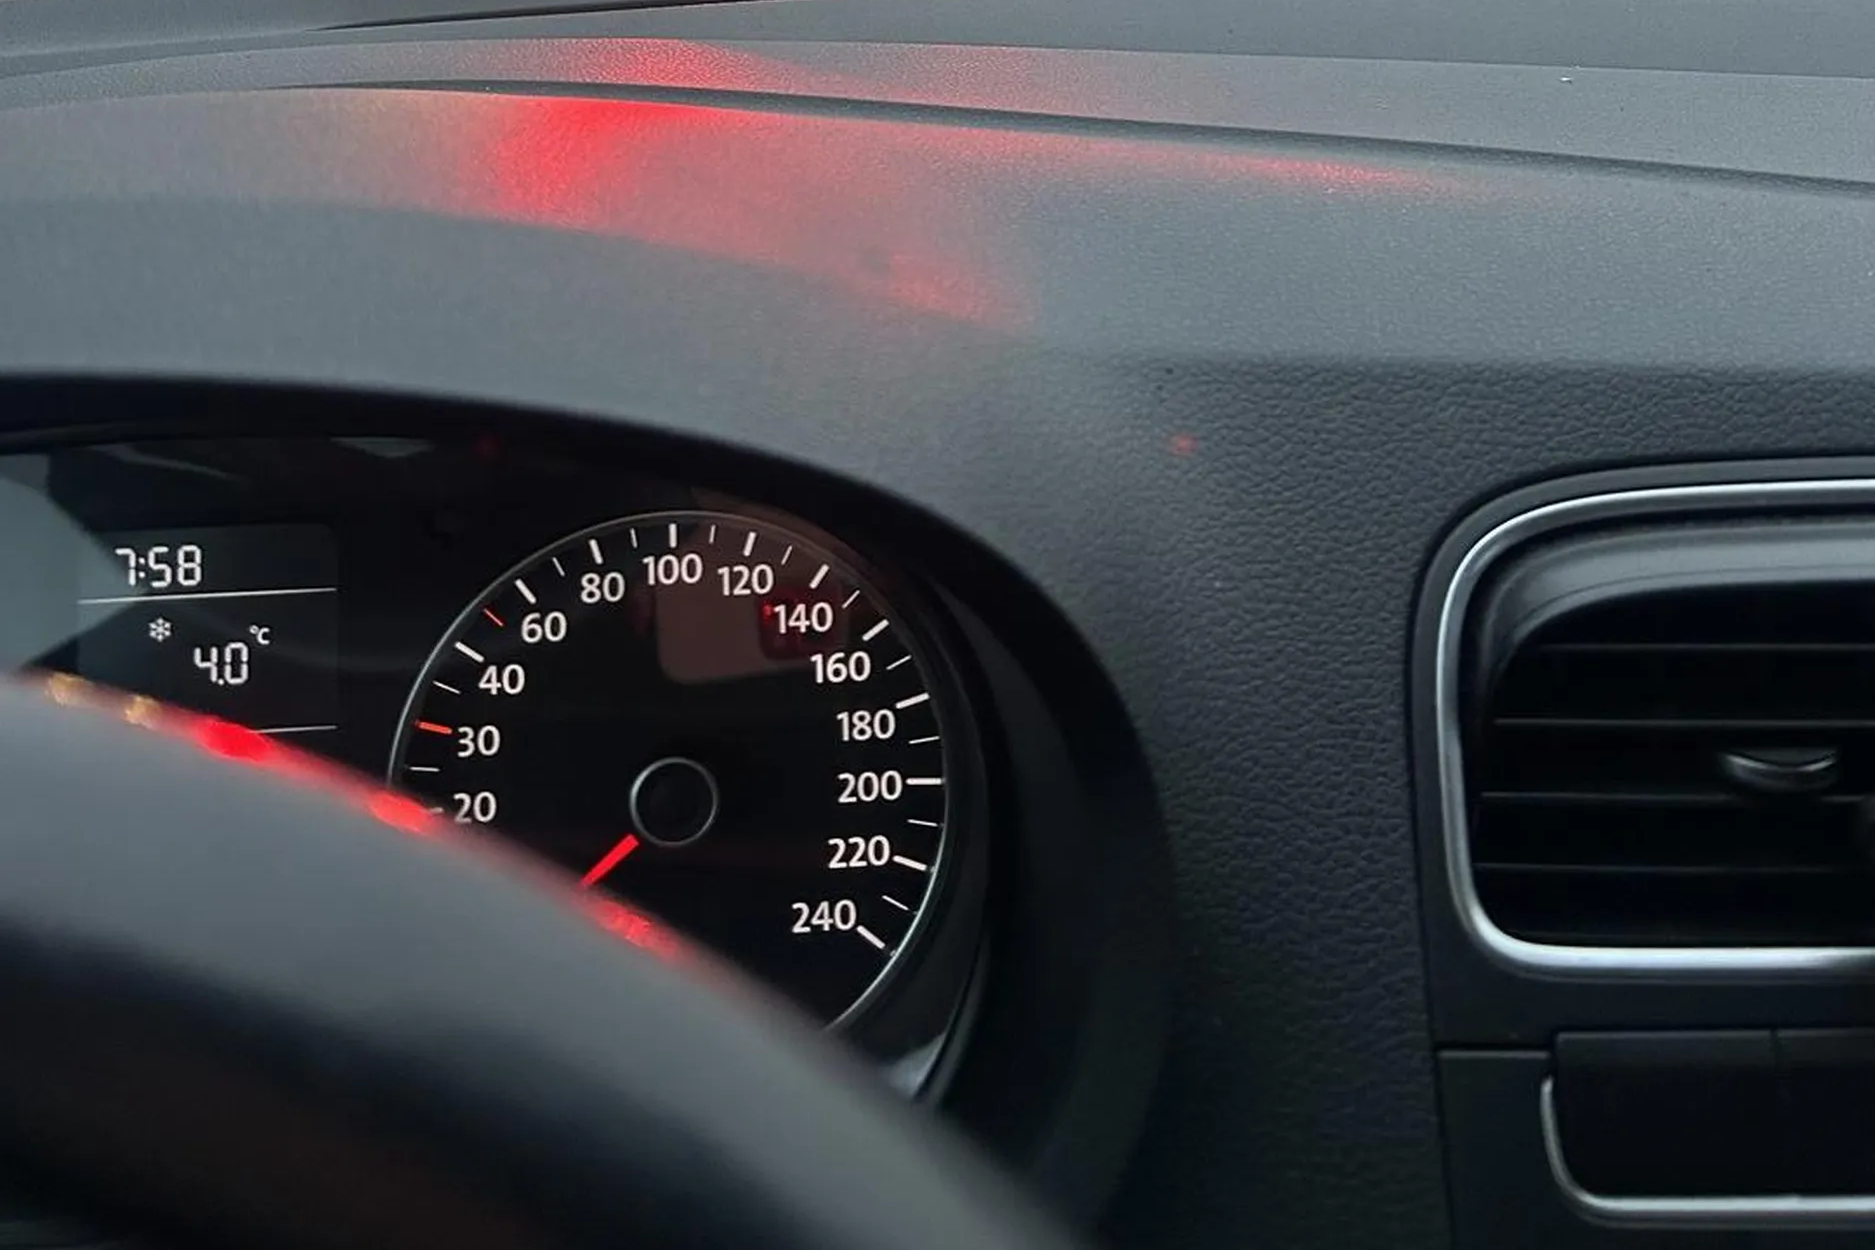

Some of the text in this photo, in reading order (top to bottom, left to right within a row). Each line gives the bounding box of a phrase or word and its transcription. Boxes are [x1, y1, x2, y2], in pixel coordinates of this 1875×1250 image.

[115, 545, 202, 588] 7:58
[642, 553, 703, 586] 100
[717, 563, 774, 596] 120
[580, 572, 625, 604] 80
[521, 611, 567, 643] 60
[773, 601, 833, 634] 140
[194, 642, 249, 685] 4.0
[478, 664, 525, 695] 40
[810, 650, 871, 684] 160
[457, 725, 501, 758] 30
[836, 708, 896, 742] 180
[838, 770, 903, 803] 200
[453, 791, 497, 823] 20
[827, 835, 890, 869] 220
[792, 899, 857, 934] 240
